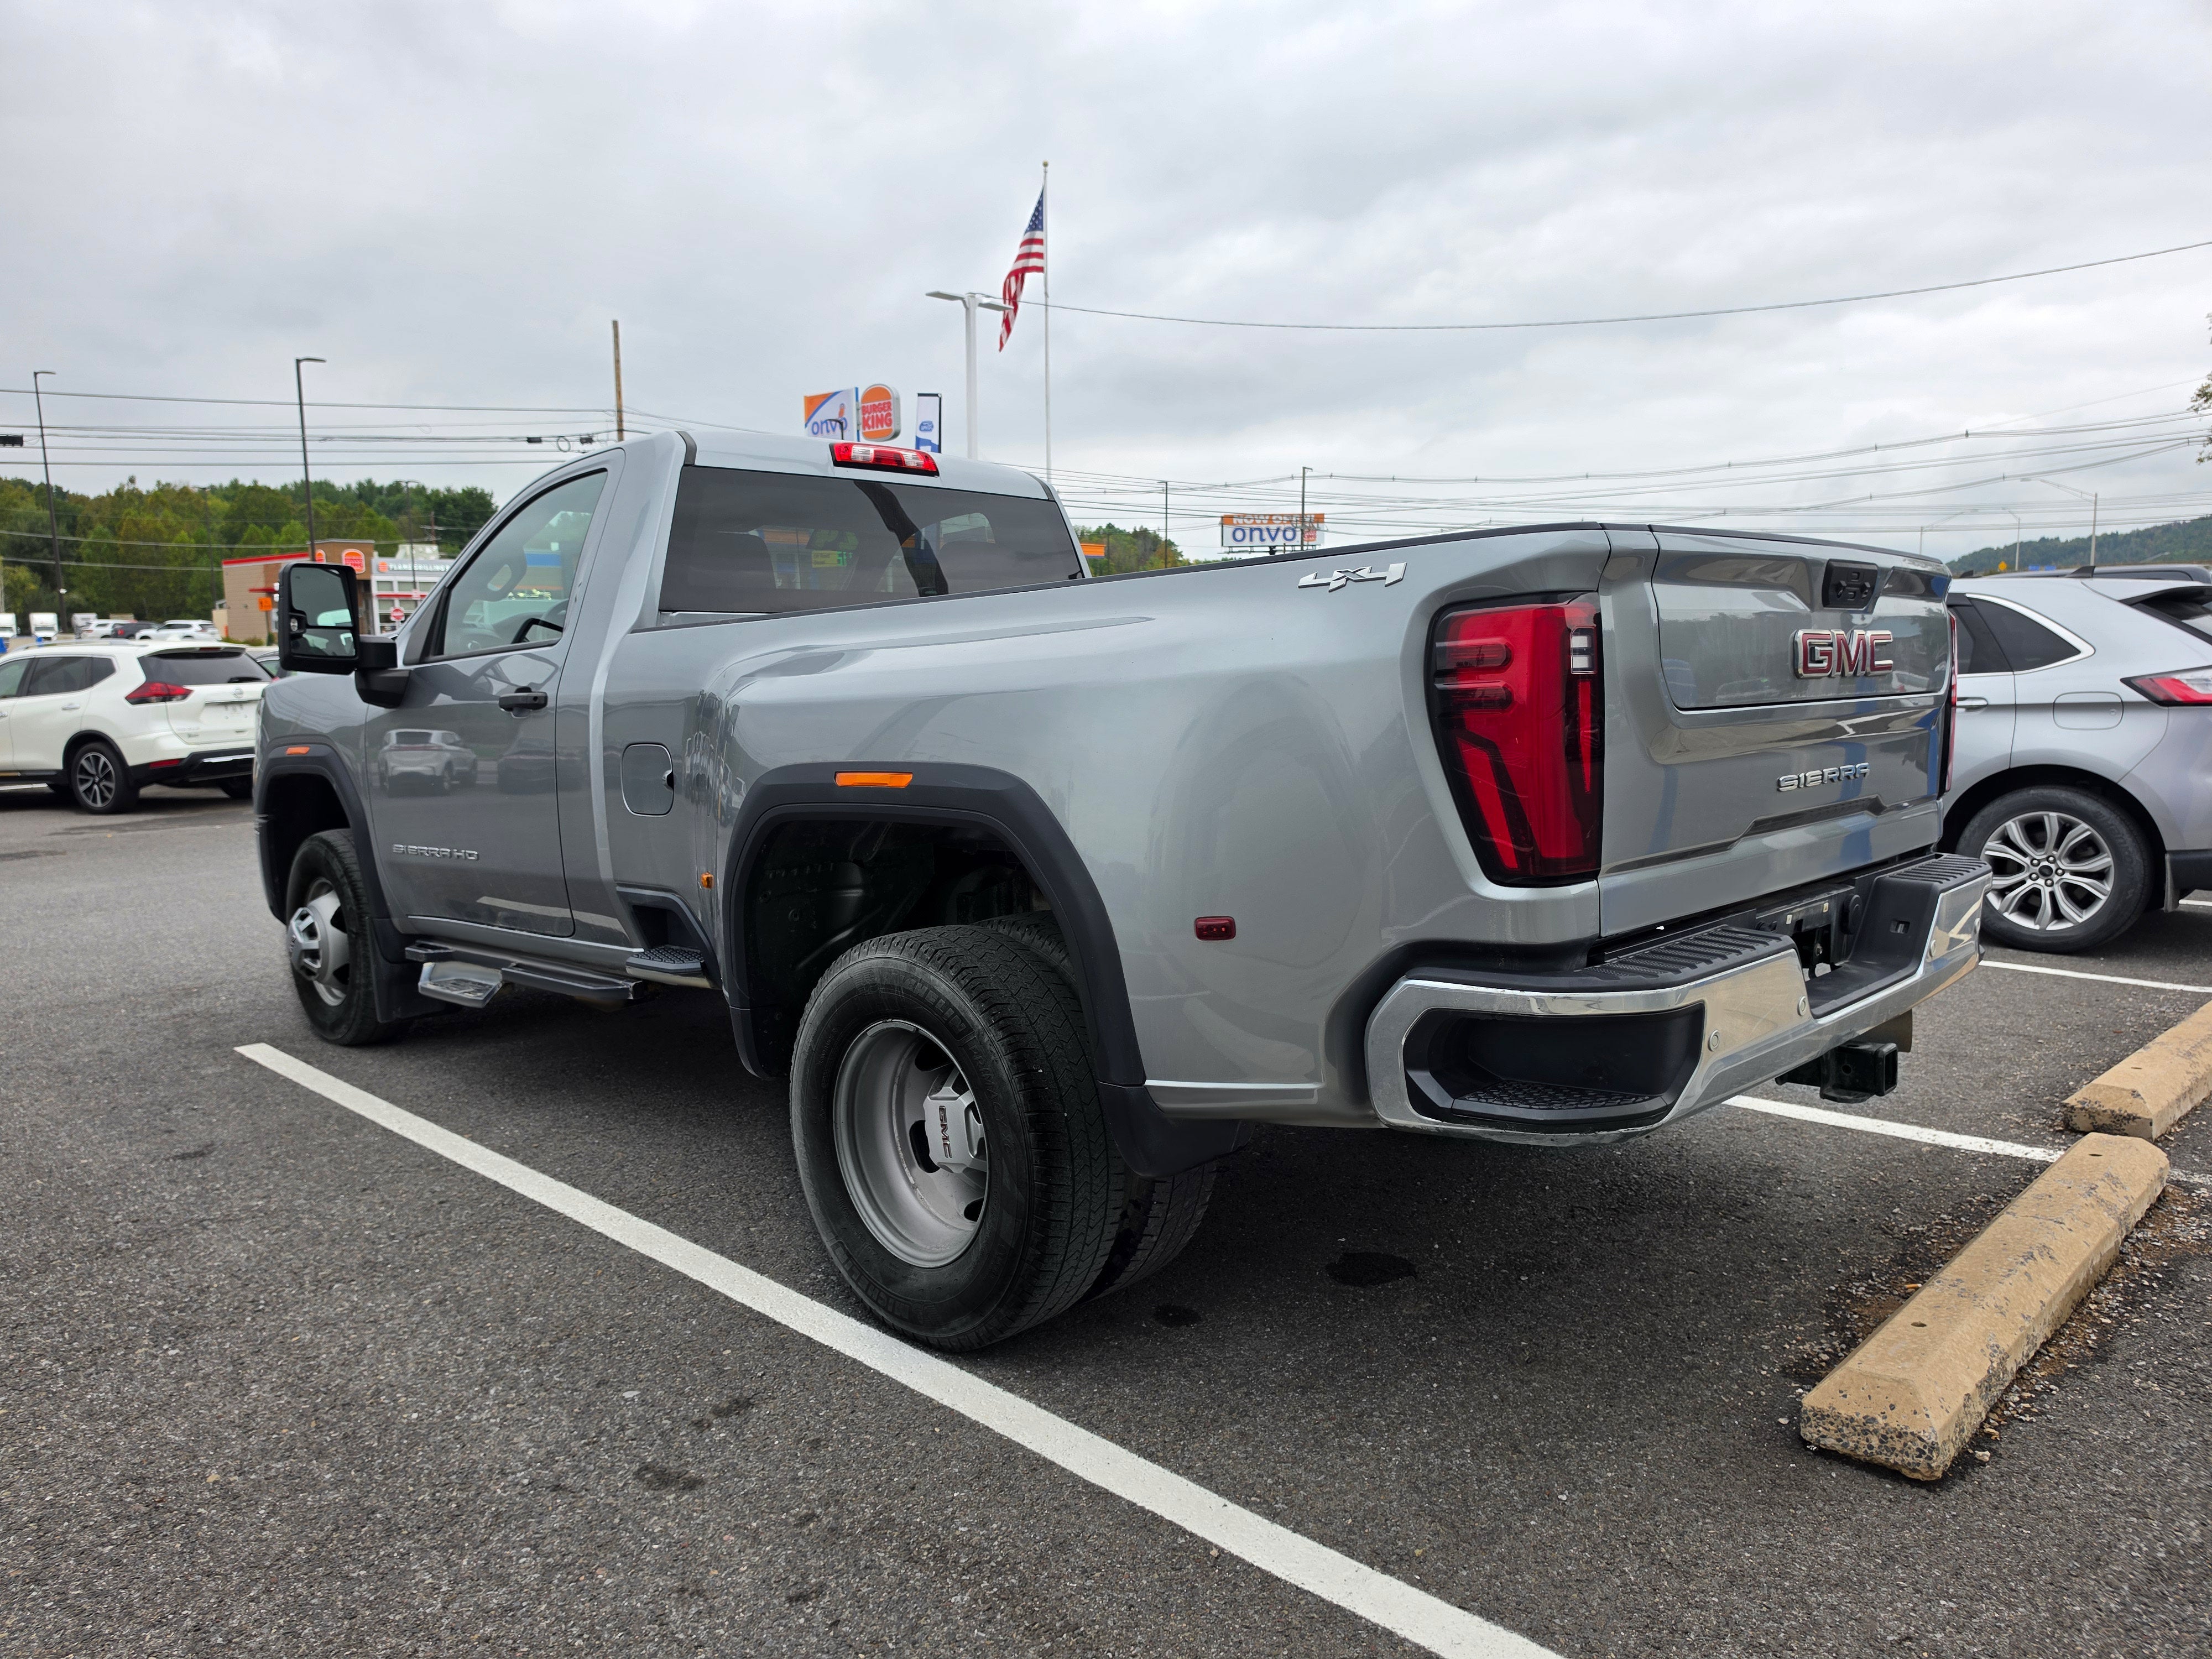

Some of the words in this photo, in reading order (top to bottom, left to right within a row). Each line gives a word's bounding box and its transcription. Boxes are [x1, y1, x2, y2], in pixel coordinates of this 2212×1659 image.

[862, 401, 891, 415] BURGER
[811, 417, 848, 435] onvo
[863, 413, 892, 430] KING
[1233, 515, 1269, 525] NOW
[1232, 526, 1296, 542] onvo
[1793, 629, 1894, 679] GMC
[1777, 762, 1870, 792] SIERRA
[392, 844, 451, 858] SIERRA
[452, 849, 479, 860] HD
[938, 1105, 953, 1159] GMC
[833, 1245, 911, 1321] MICHELIN
